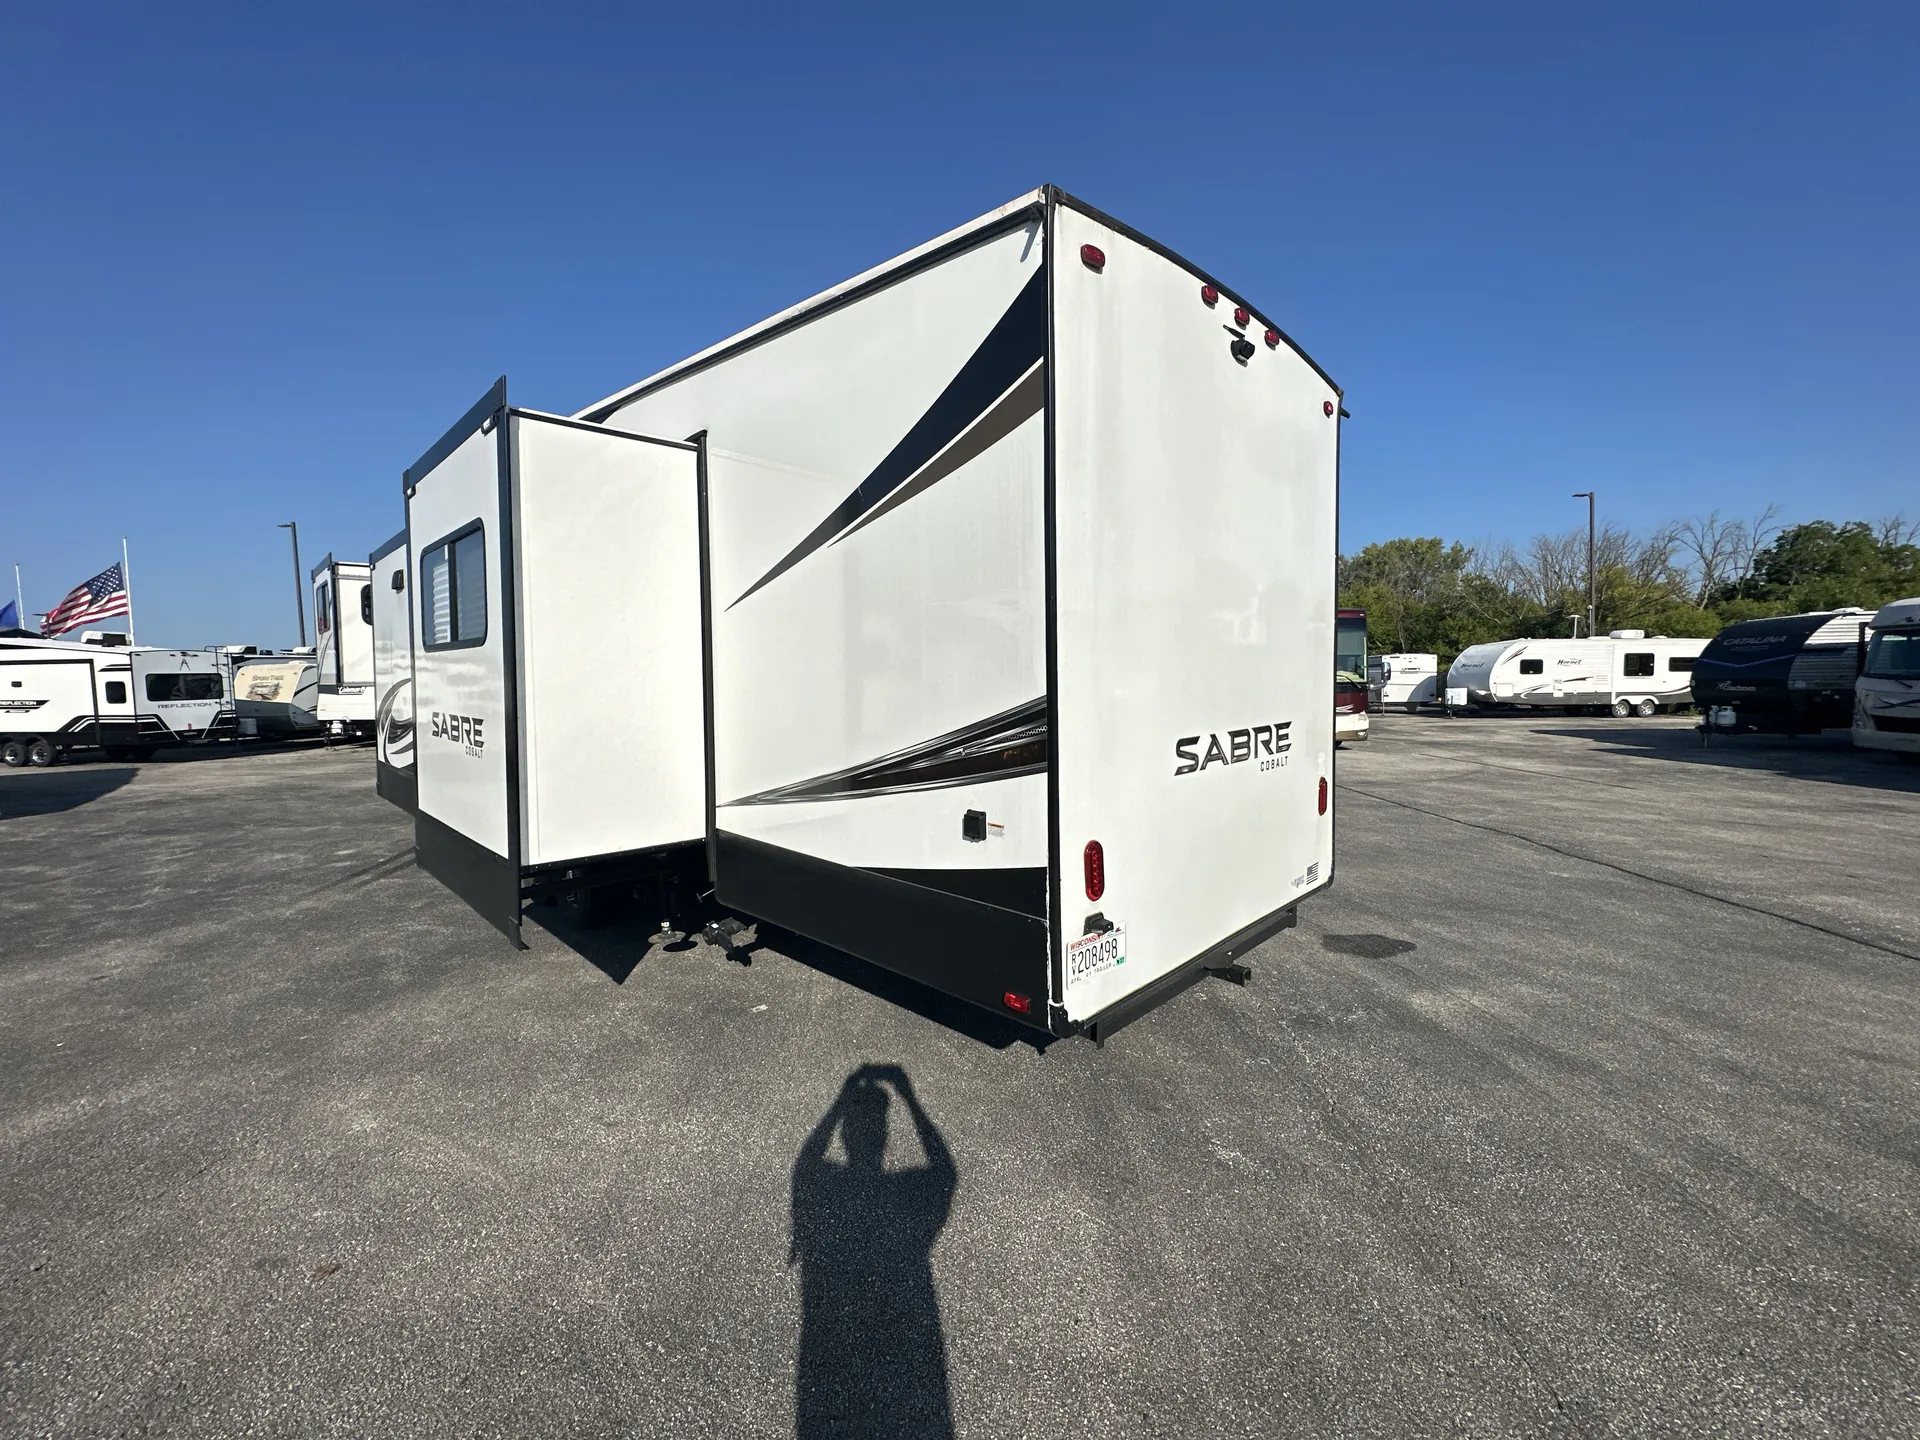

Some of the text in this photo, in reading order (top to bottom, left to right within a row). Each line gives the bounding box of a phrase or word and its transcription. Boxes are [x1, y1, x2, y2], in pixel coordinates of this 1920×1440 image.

[1722, 636, 1788, 646] CATALINA
[431, 711, 485, 749] SABRE
[1173, 720, 1293, 777] SABRE
[1260, 755, 1289, 772] COBALT
[1077, 938, 1118, 974] 208498
